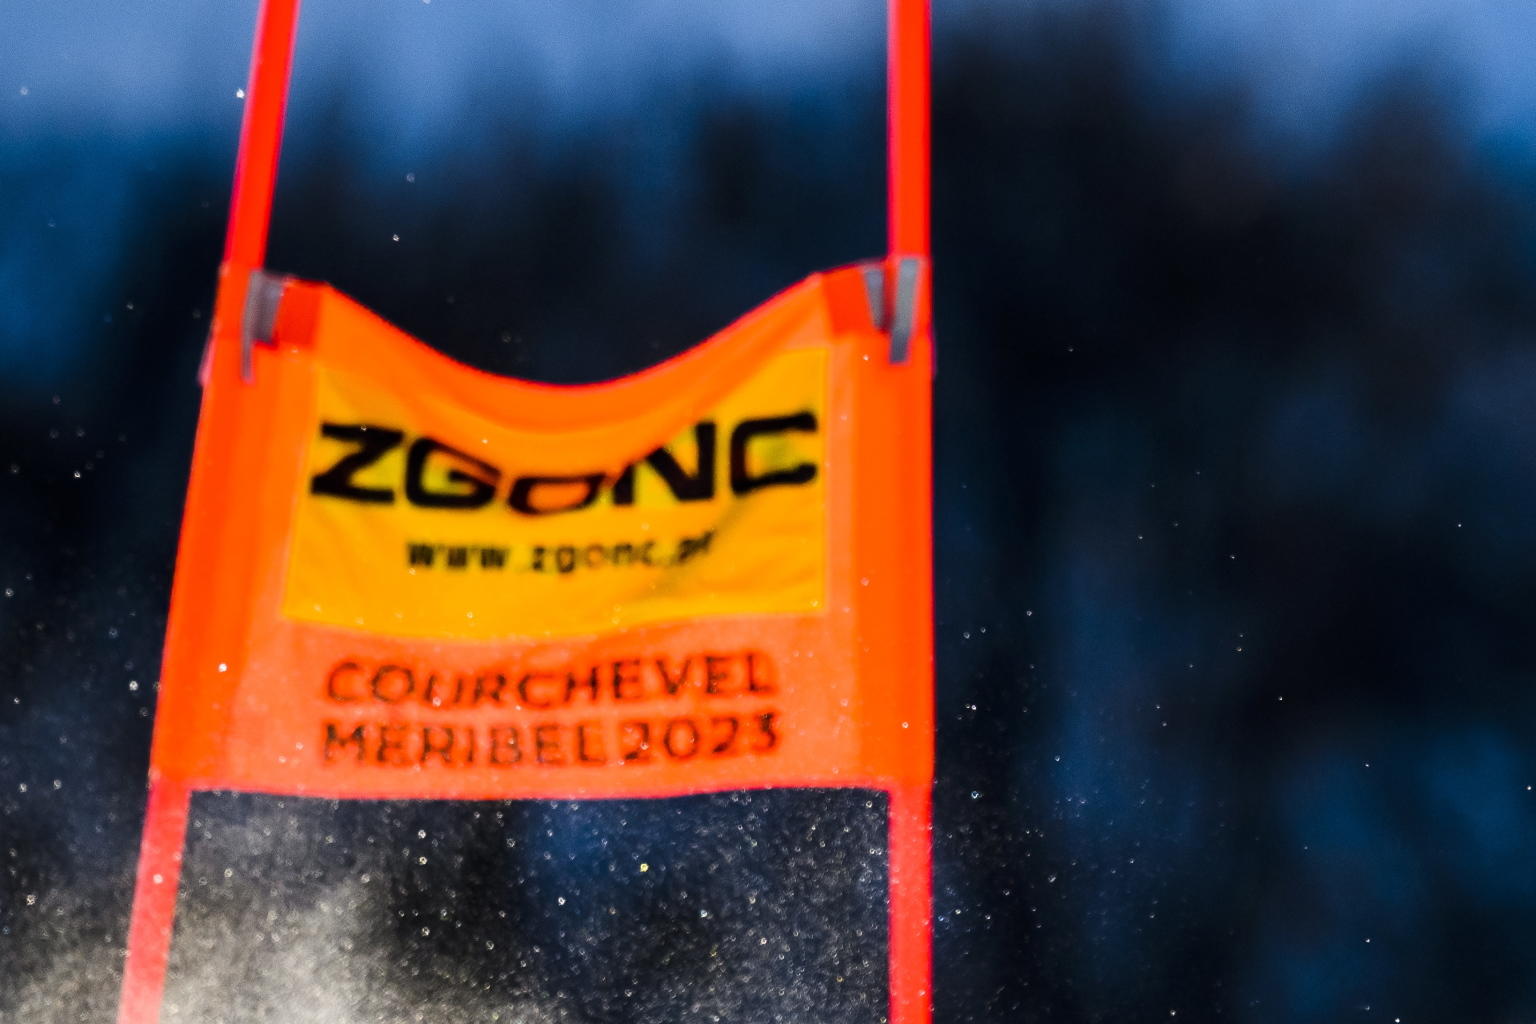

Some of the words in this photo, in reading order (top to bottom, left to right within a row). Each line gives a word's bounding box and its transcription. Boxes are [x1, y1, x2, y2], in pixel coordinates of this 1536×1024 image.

[309, 410, 818, 515] ZGONC
[327, 653, 772, 710] COURCHEVEL
[621, 712, 779, 760] 2023
